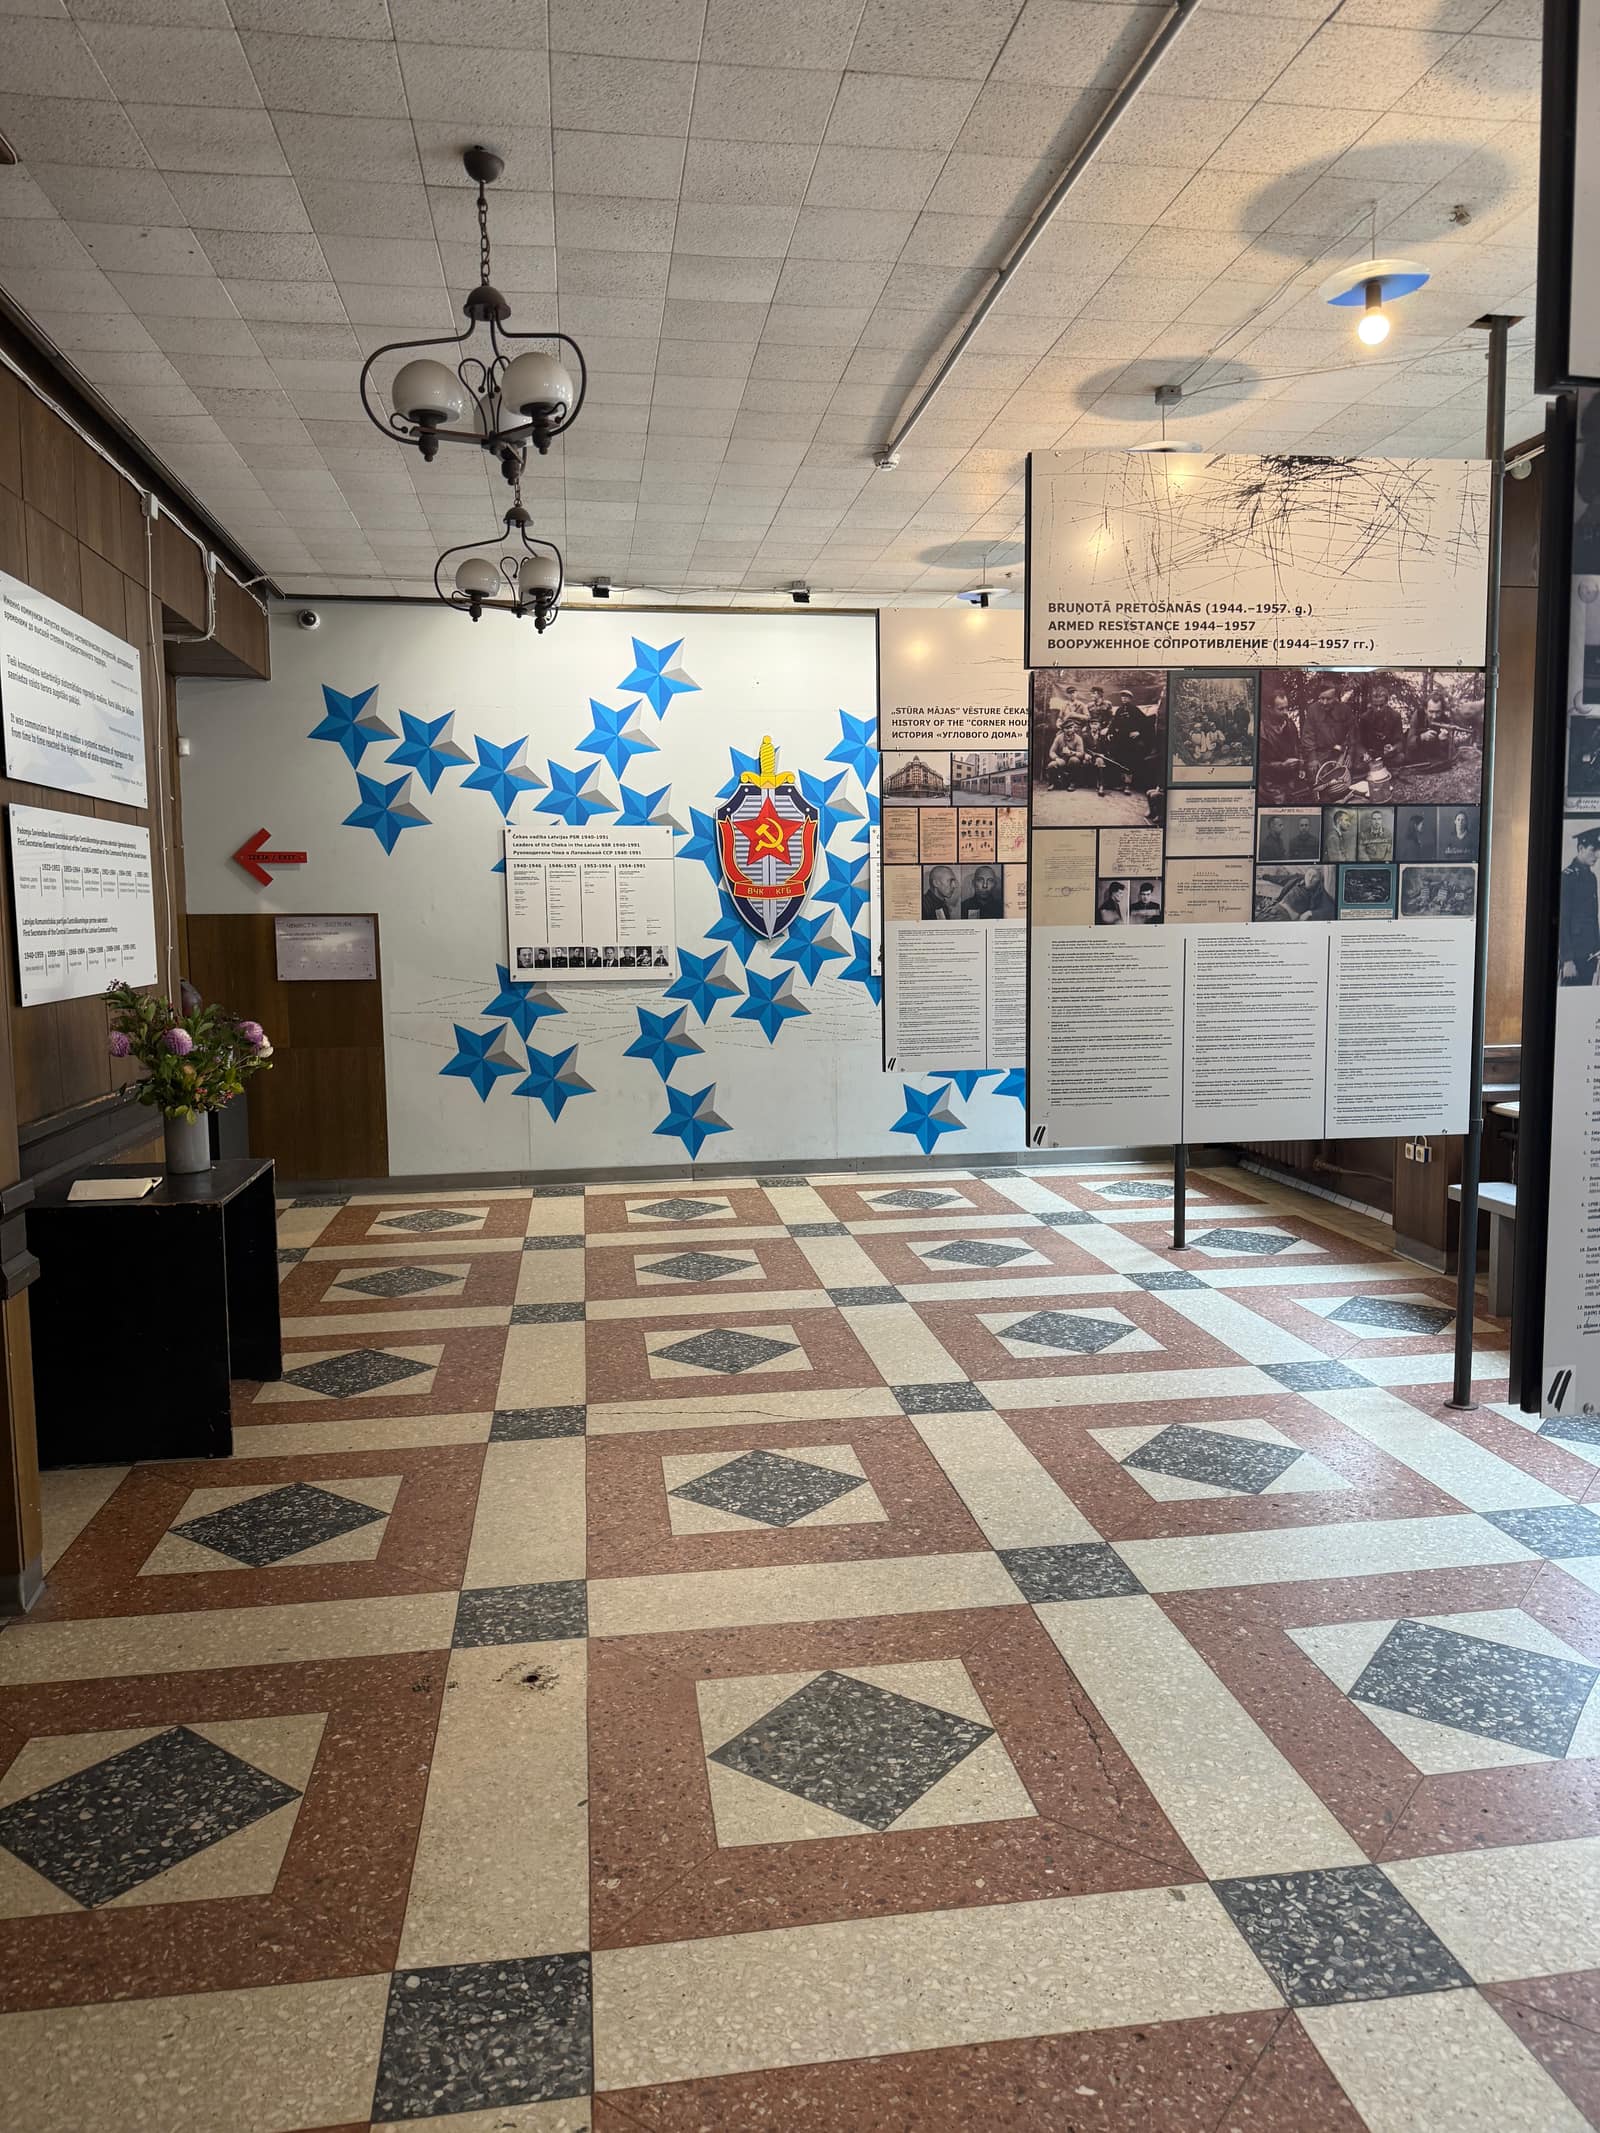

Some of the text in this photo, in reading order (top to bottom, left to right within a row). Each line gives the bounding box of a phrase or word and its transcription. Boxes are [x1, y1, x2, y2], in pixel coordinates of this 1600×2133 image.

[1048, 600, 1111, 615] BRUŅOTĀ
[1115, 600, 1201, 613] PRETOŠANĀS
[1048, 621, 1256, 632] ARMED RESISTANCE 1944–1957
[1047, 638, 1149, 649] ВООРУЖЕННОЕ
[1153, 638, 1268, 649] СОПРОТИВЛЕНИЕ
[963, 706, 1000, 714] VĒSTURE
[892, 719, 931, 727] HISTORY
[933, 719, 945, 727] OF
[948, 719, 964, 727] THE
[1009, 719, 1027, 727] HOU
[892, 731, 934, 739] ИСТОРИЯ
[936, 731, 989, 739] «УГЛОВОГО
[991, 731, 1023, 740] ДОМА»
[747, 887, 791, 895] ВЧК КГБ
